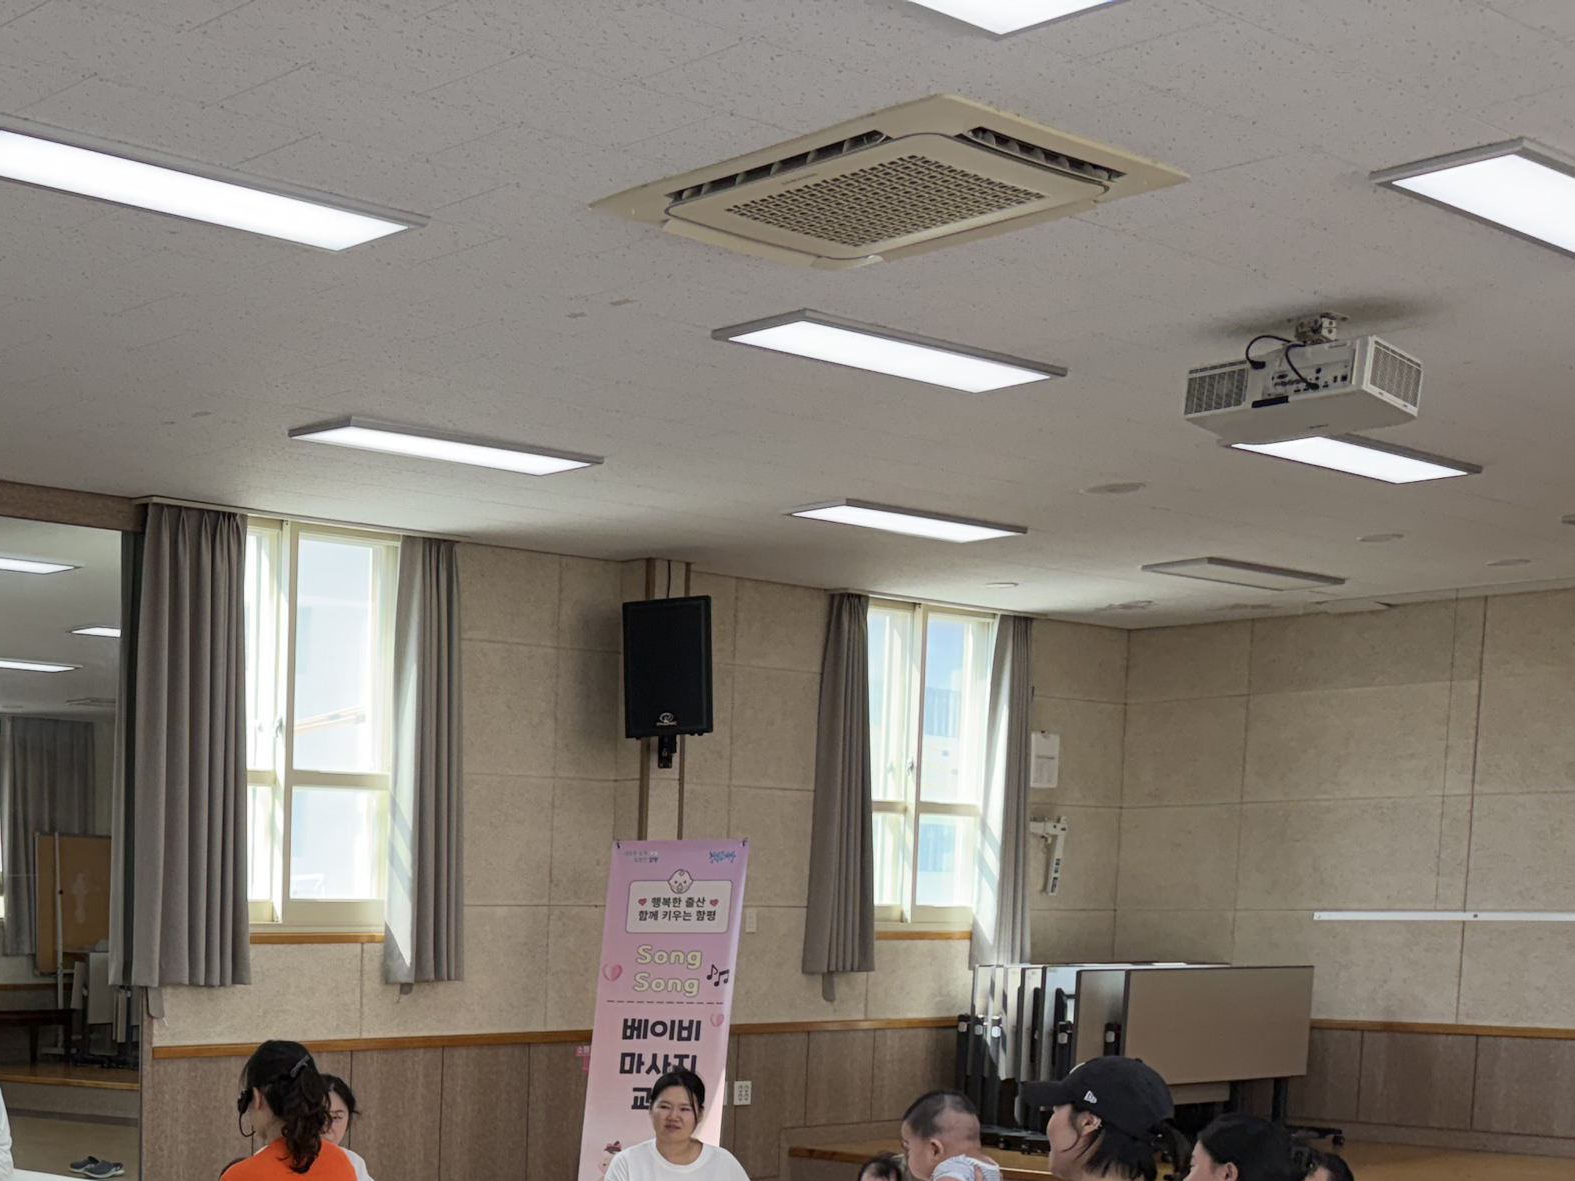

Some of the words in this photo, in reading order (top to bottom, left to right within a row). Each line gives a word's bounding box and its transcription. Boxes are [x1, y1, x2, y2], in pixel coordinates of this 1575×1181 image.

[651, 897, 682, 908] 행복한
[685, 897, 706, 908] 출산
[638, 910, 659, 921] 함께
[661, 910, 693, 921] 키우는
[695, 910, 717, 922] 함평
[635, 943, 703, 970] Song
[632, 971, 700, 998] Song
[621, 1018, 702, 1042] 베이비
[619, 1052, 698, 1076] 마사지
